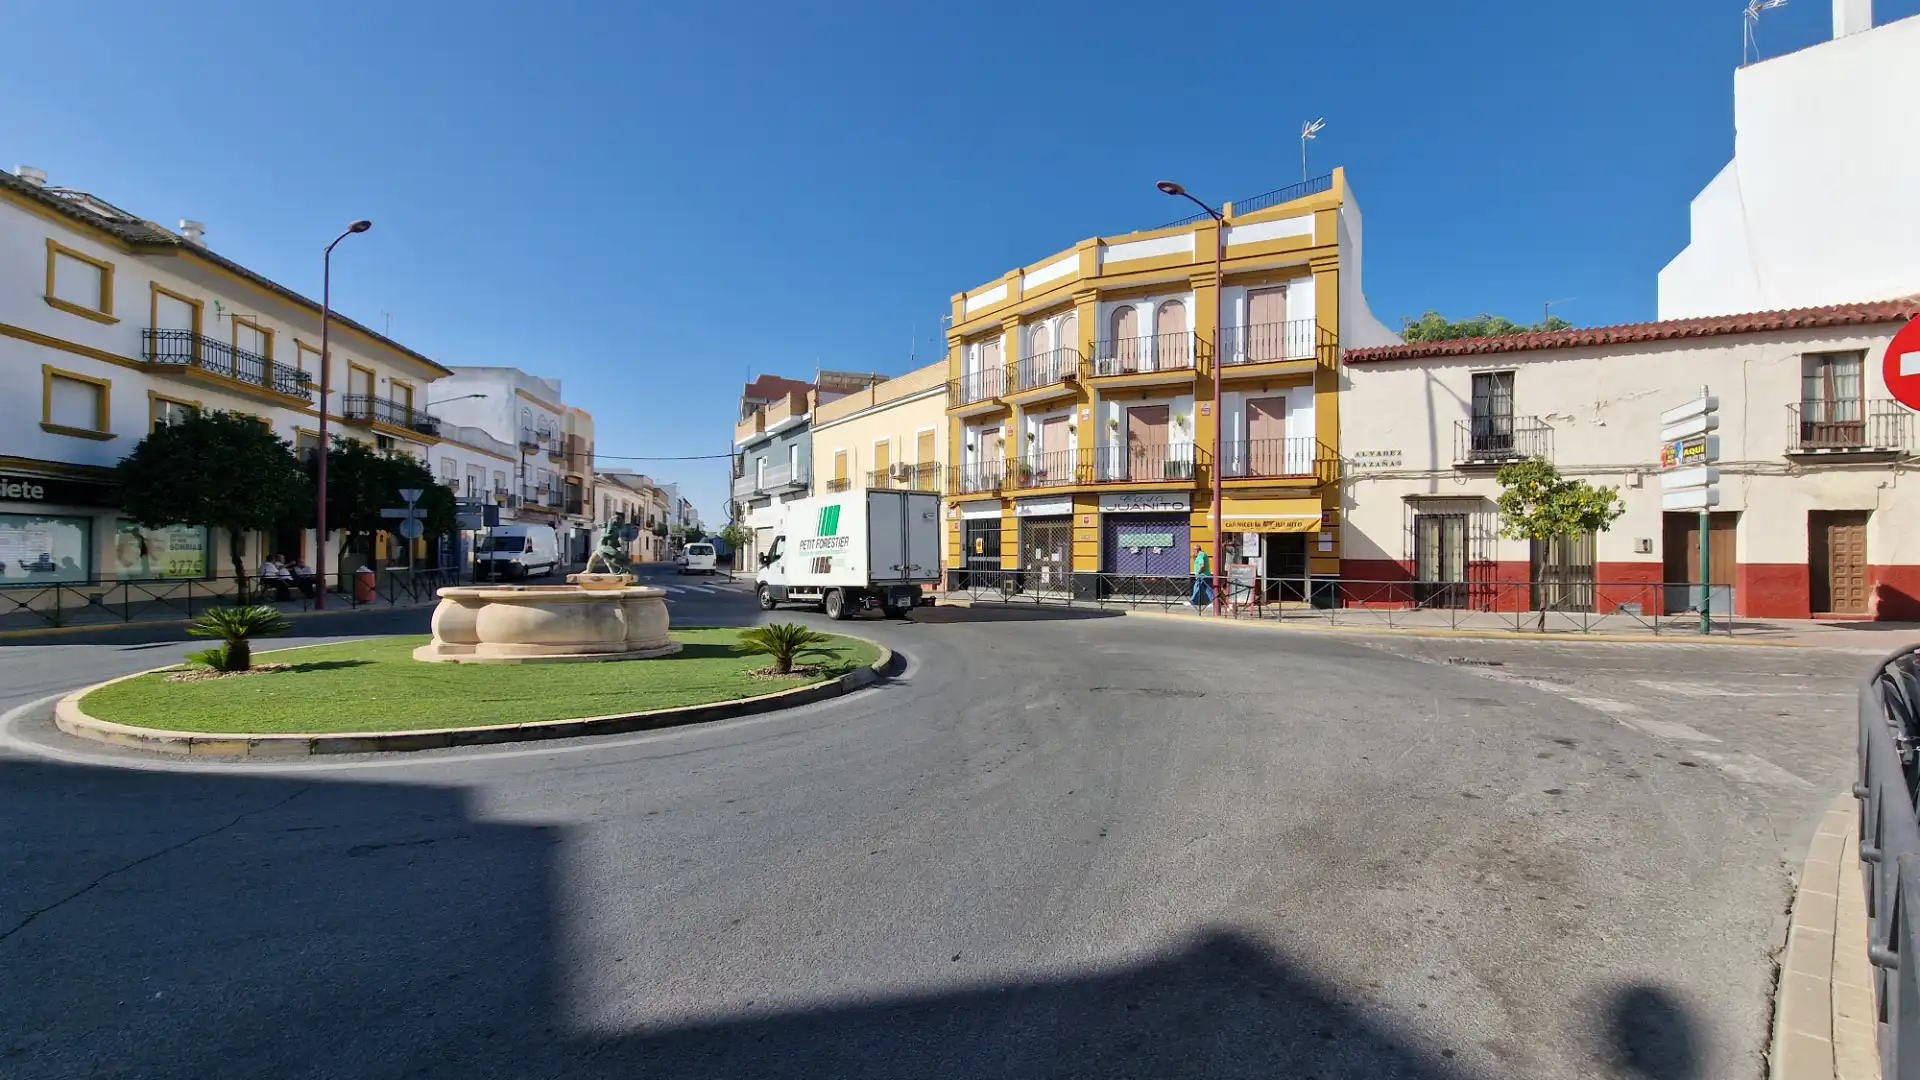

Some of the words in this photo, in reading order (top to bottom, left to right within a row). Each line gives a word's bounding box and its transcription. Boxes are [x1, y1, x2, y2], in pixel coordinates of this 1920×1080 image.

[0, 479, 44, 499] iete
[1105, 502, 1185, 512] JUANITO
[800, 539, 816, 550] PETIT
[816, 536, 849, 549] FORESTIER
